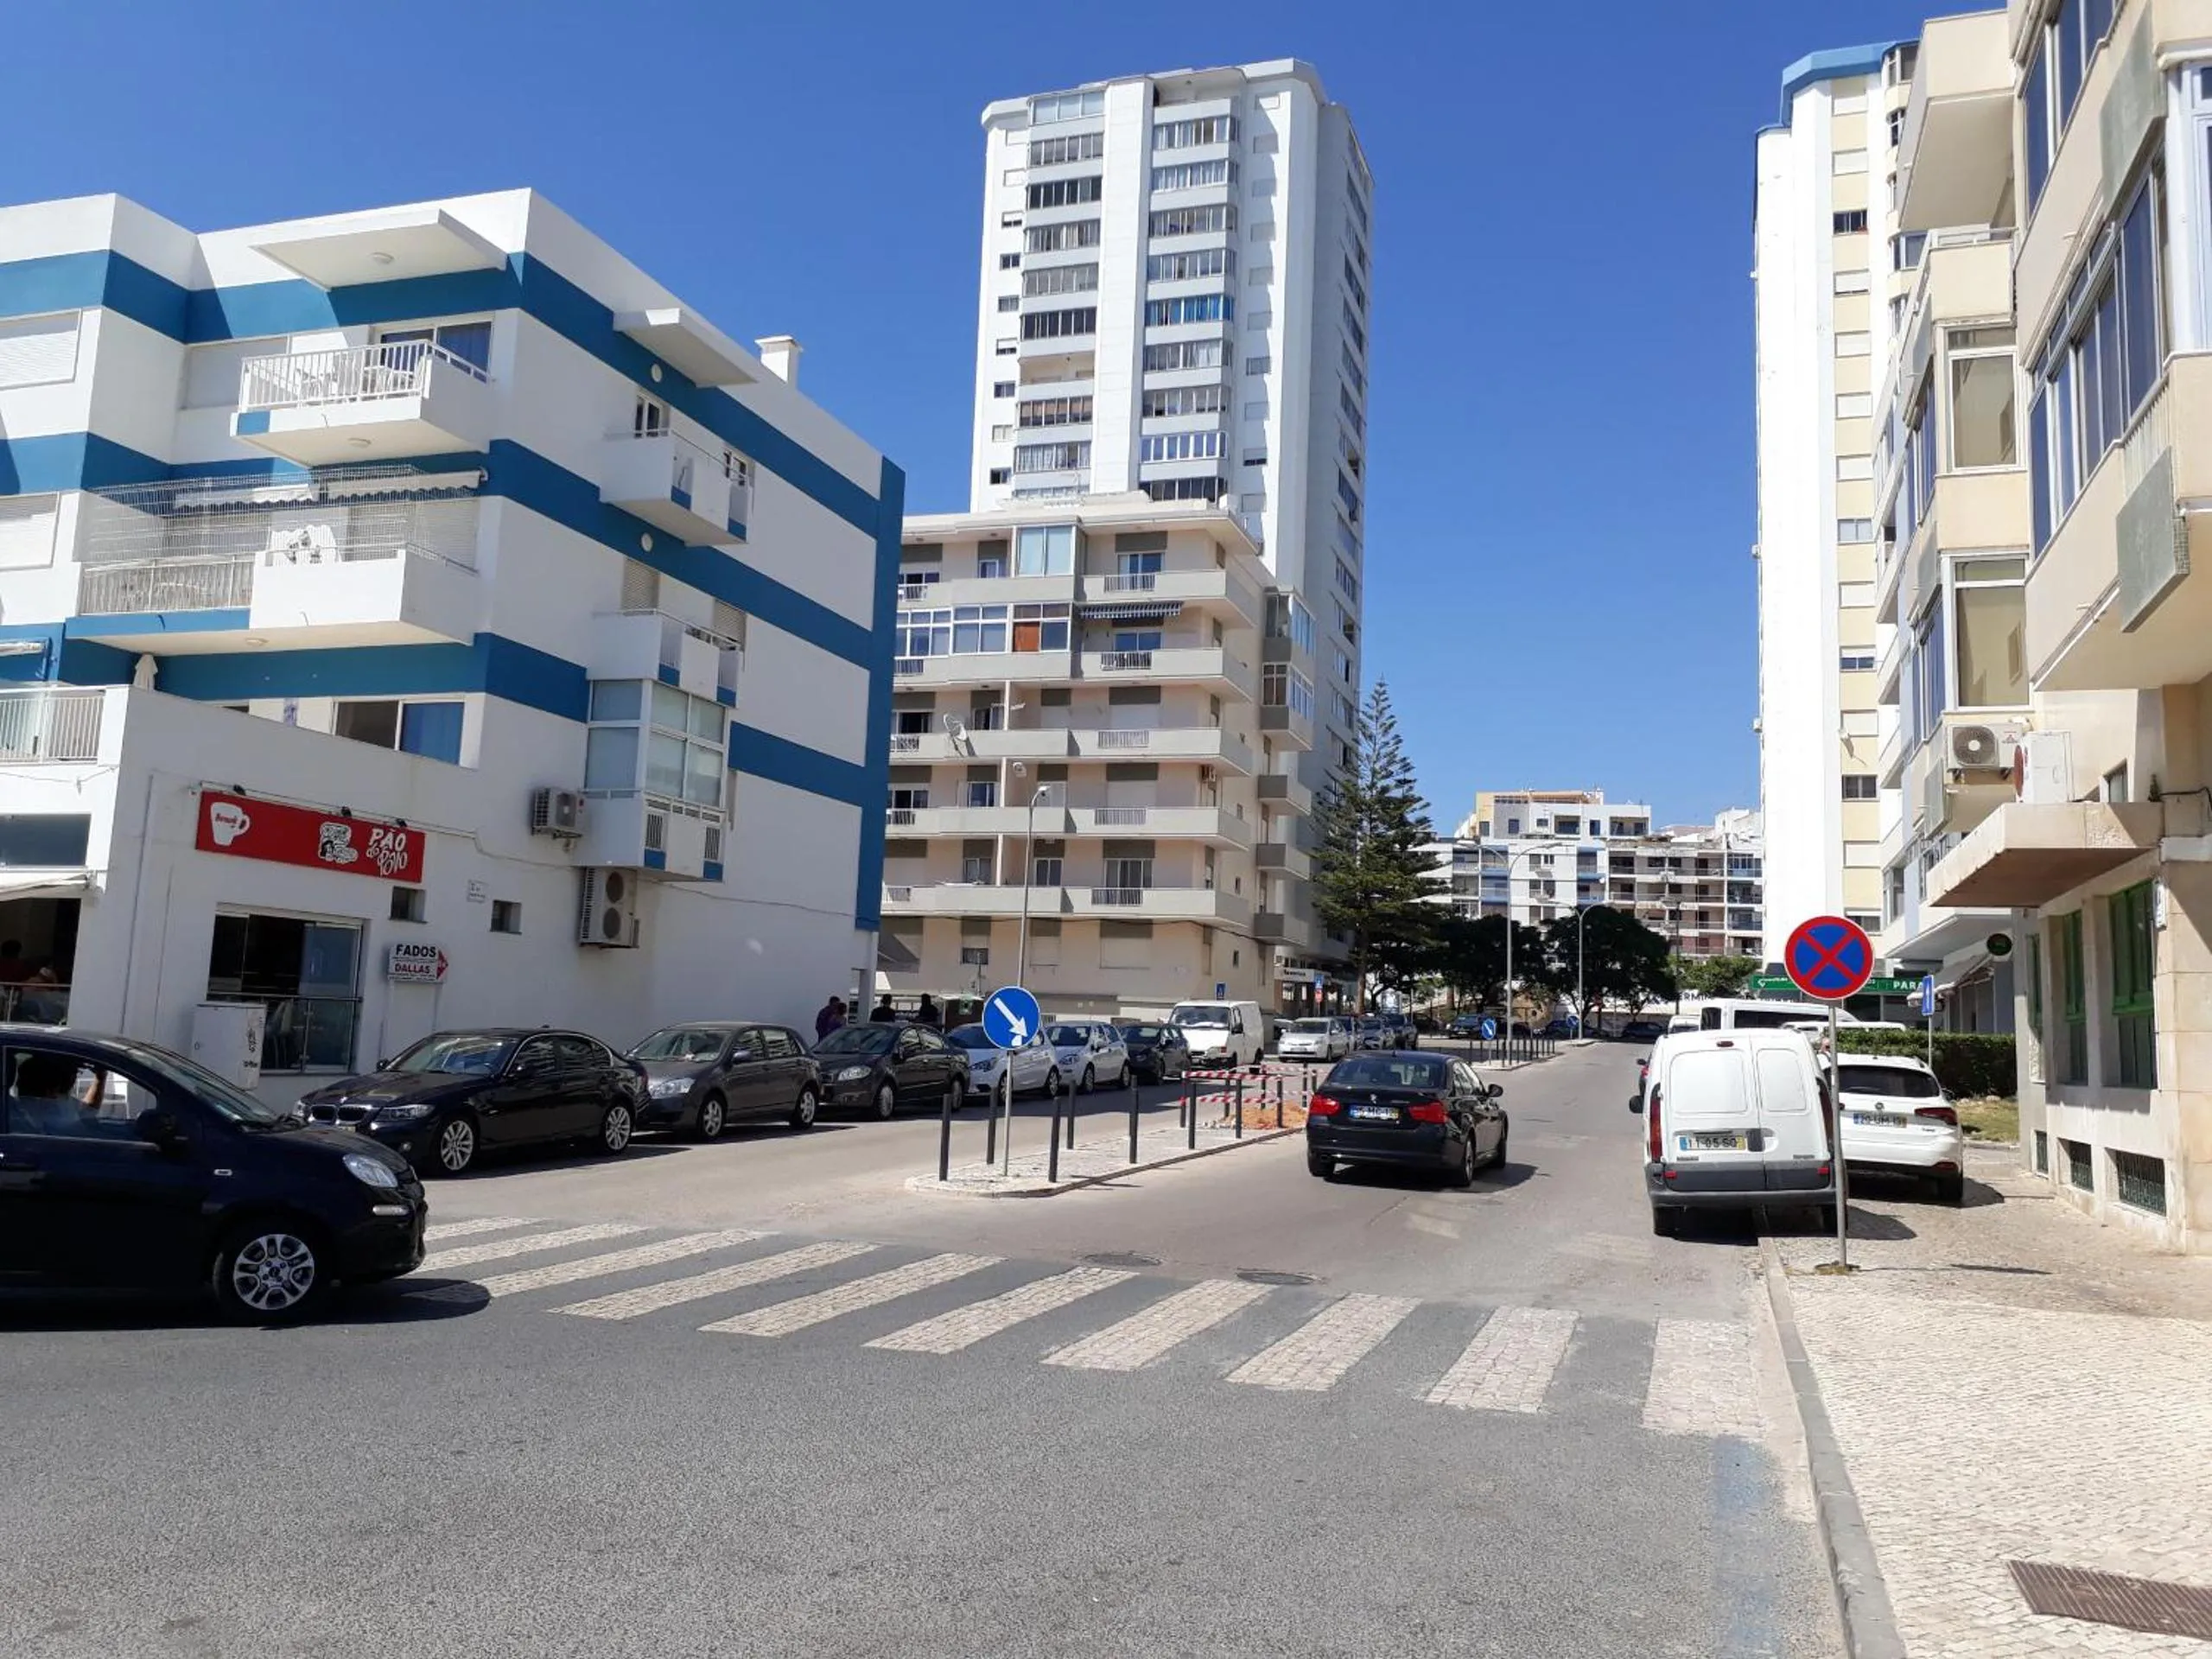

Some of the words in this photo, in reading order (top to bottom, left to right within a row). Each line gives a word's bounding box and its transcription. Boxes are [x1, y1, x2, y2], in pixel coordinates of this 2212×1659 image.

[369, 828, 407, 852] PÃO
[396, 944, 436, 957] FADOS
[395, 963, 430, 974] DALLAS
